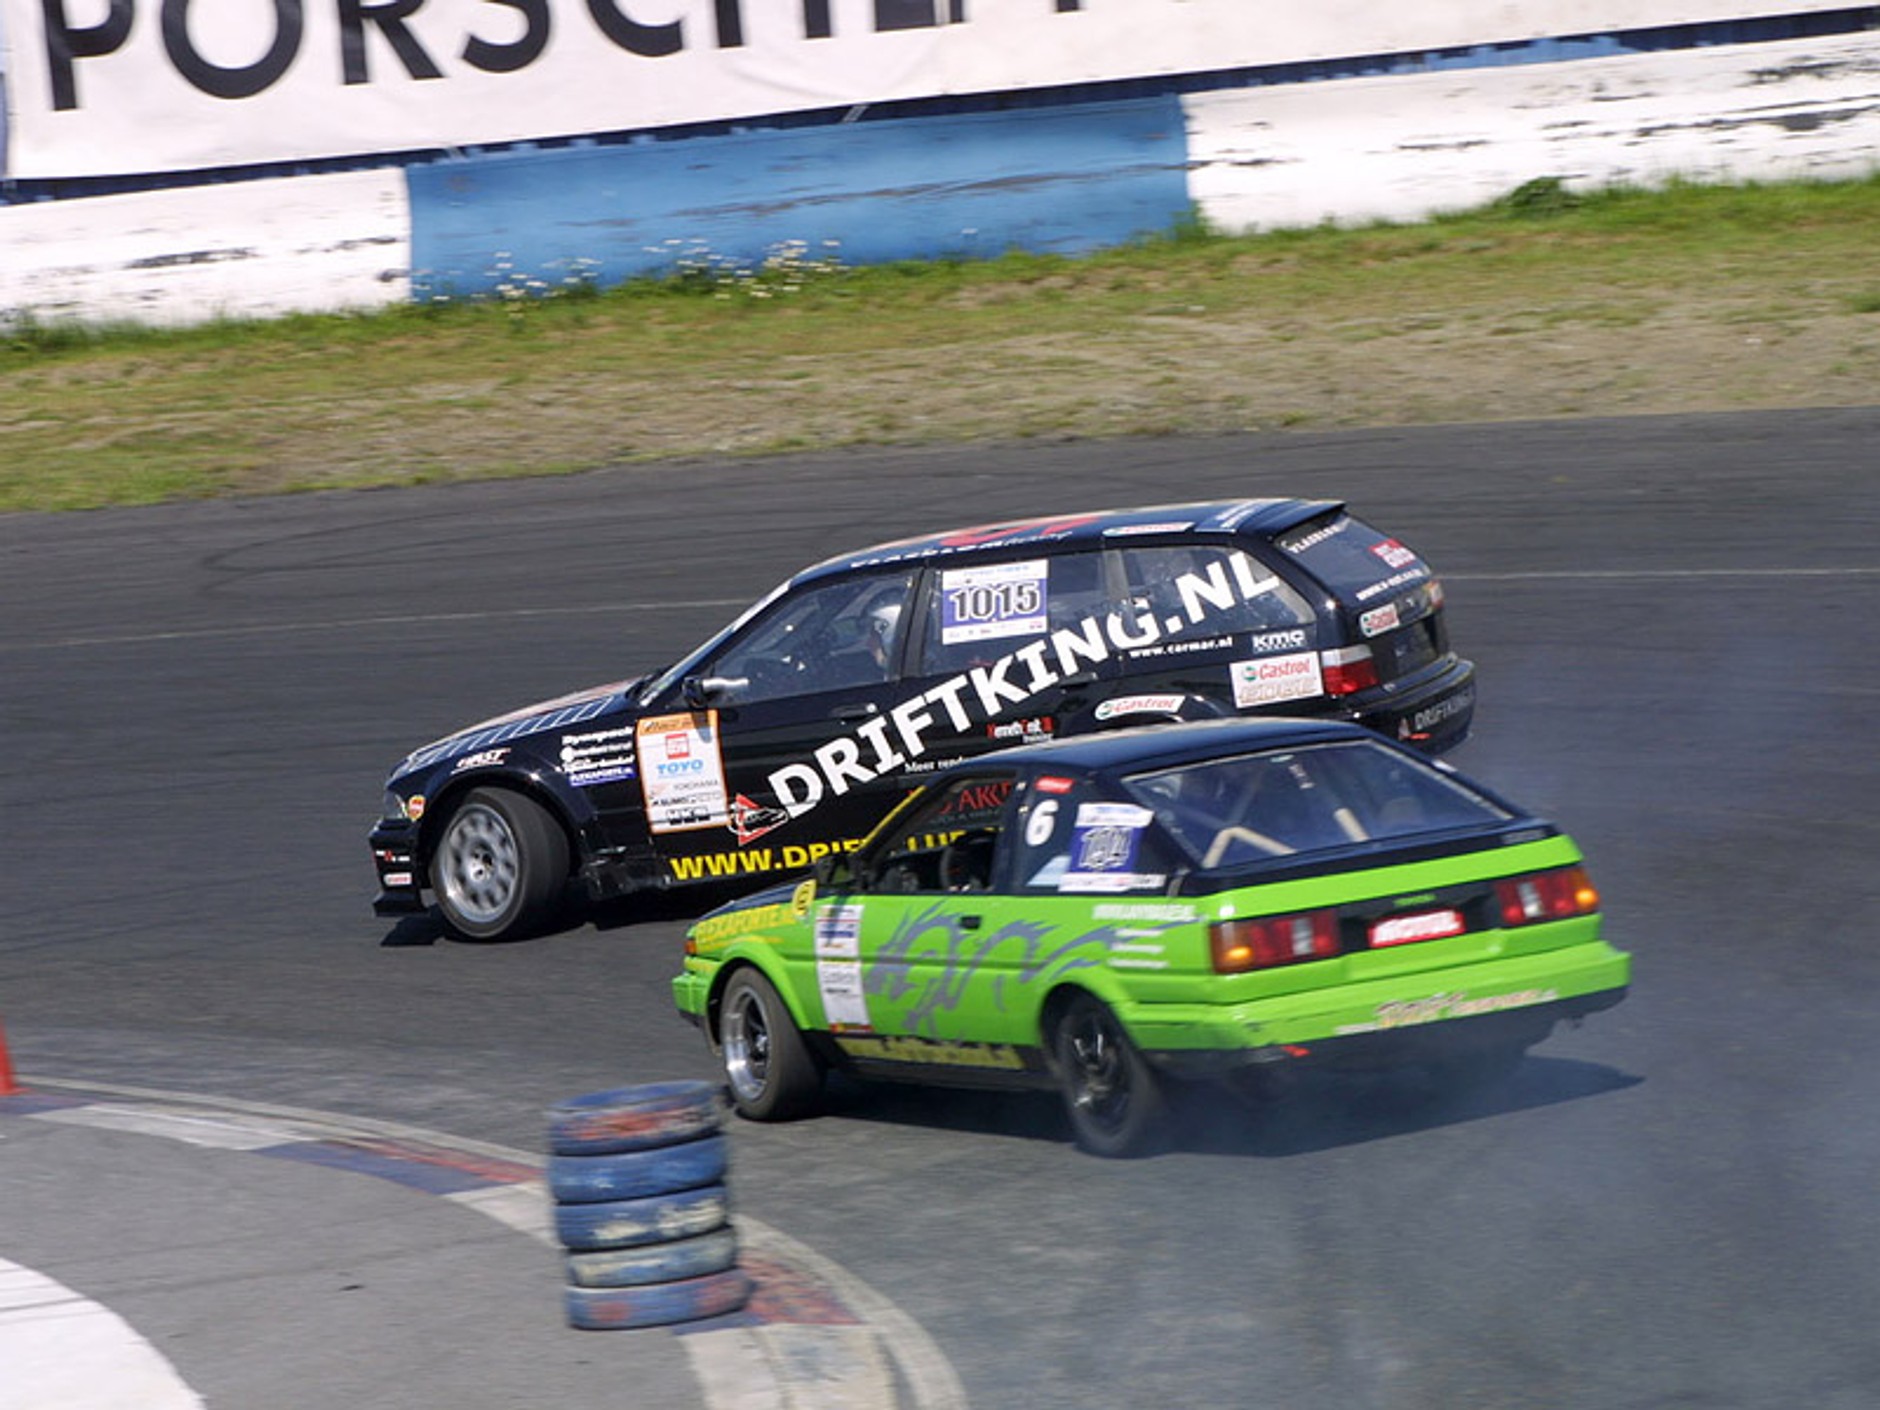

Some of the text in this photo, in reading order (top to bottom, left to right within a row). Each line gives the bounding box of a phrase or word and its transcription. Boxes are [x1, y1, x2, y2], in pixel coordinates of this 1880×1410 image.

[949, 579, 1041, 622] 1015
[767, 550, 1281, 818] DRIFTKING.NL
[1258, 658, 1311, 680] Castrol
[1112, 696, 1177, 714] Castrol
[656, 759, 704, 775] TOYO
[1025, 798, 1059, 847] 6
